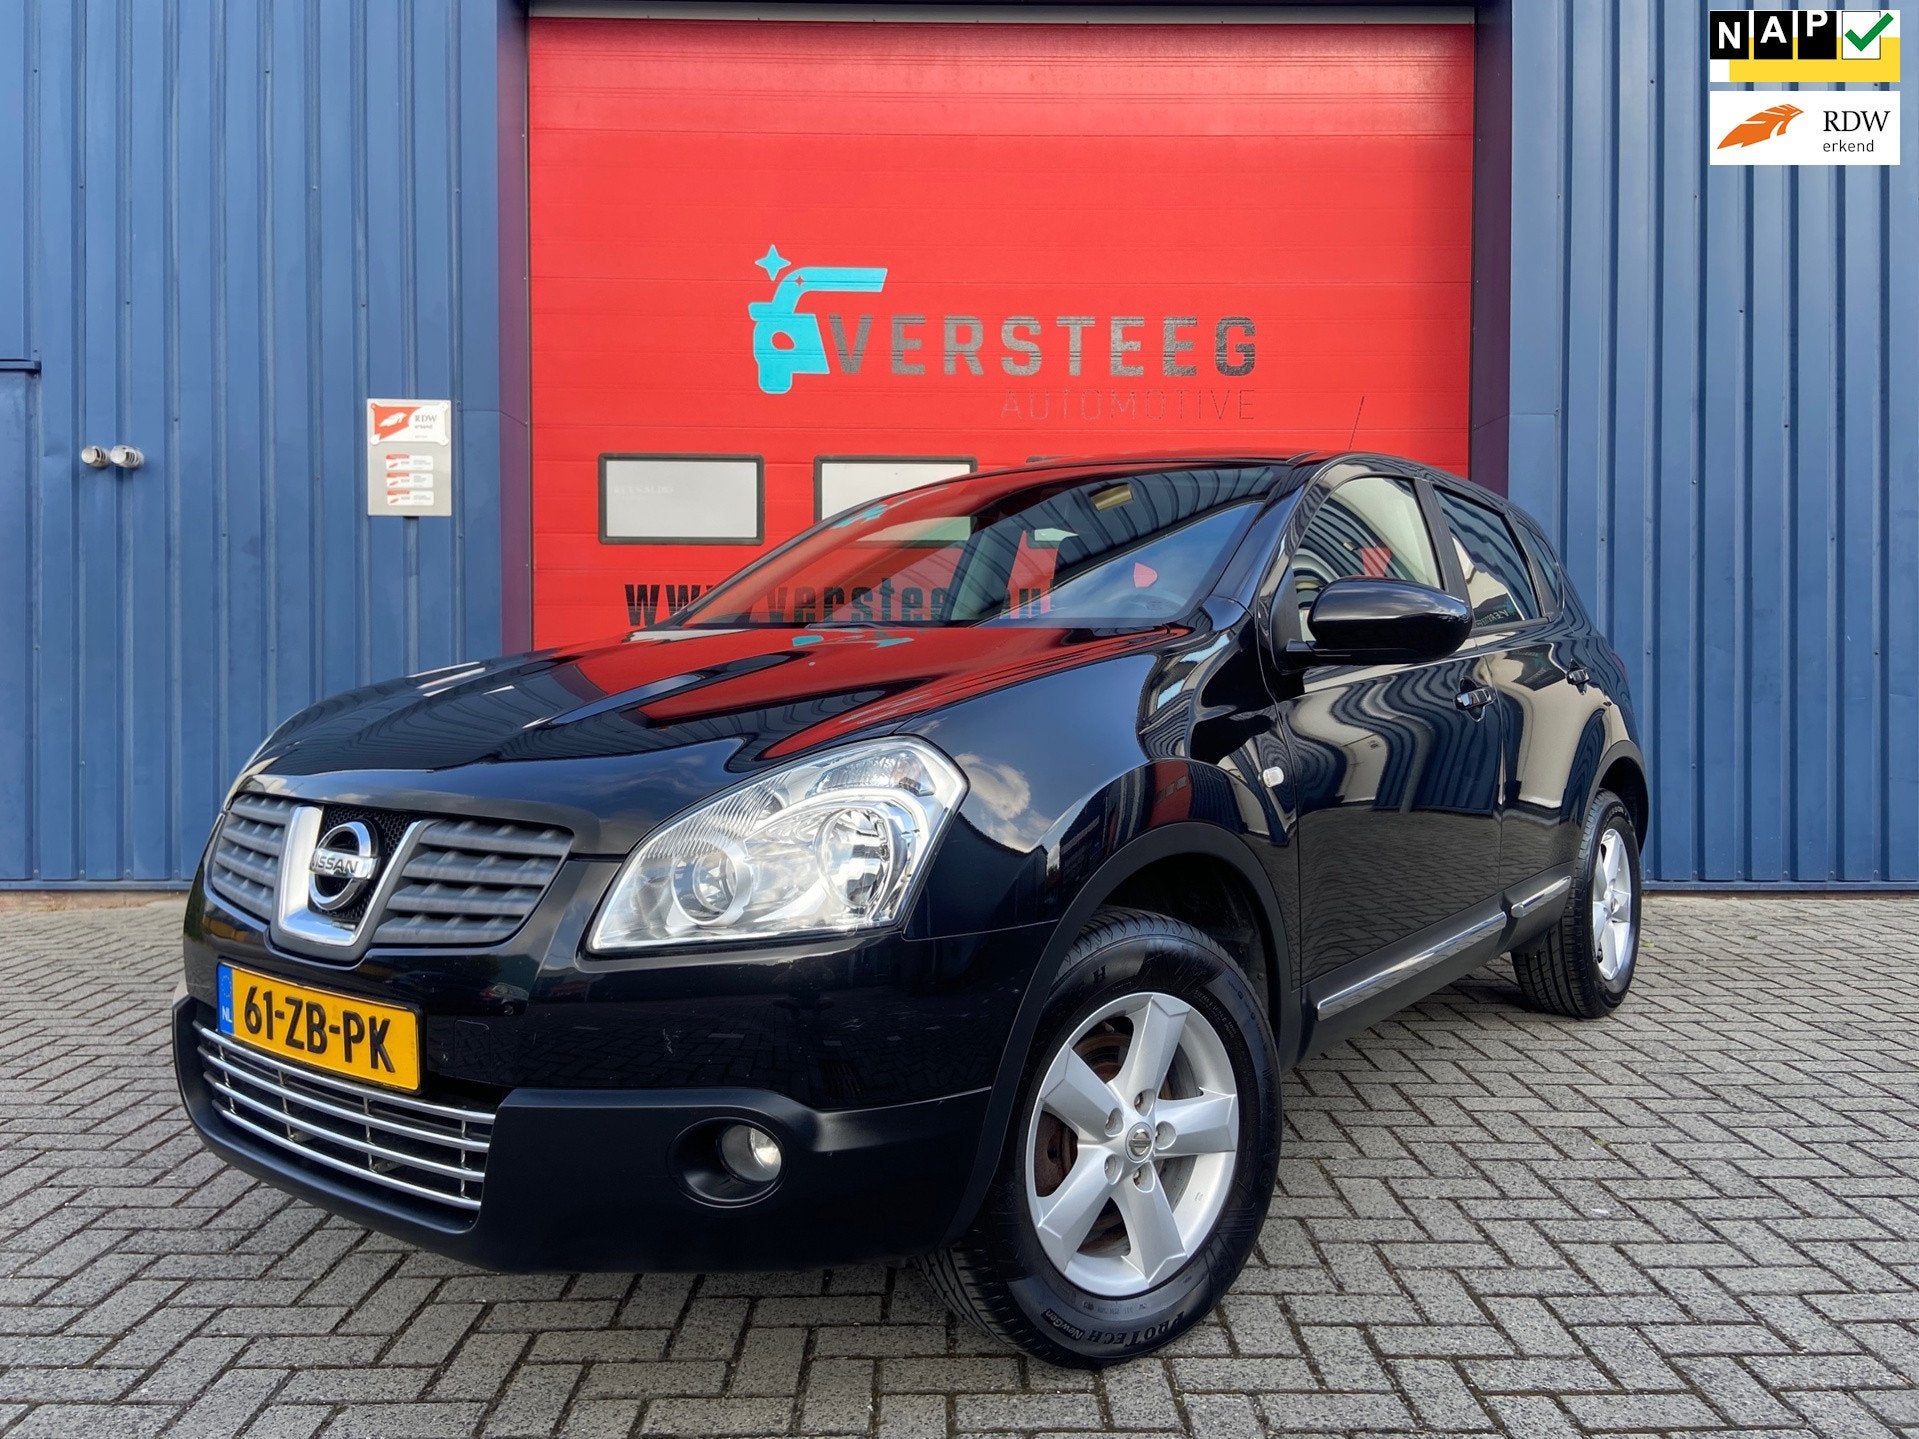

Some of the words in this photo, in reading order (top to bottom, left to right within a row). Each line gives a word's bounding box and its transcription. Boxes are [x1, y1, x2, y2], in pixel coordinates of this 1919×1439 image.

[829, 315, 1257, 377] VERSTEEG
[1001, 389, 1255, 421] AUTOMOTIVE
[221, 1005, 233, 1023] NL
[244, 985, 395, 1073] 61-ZB-PK
